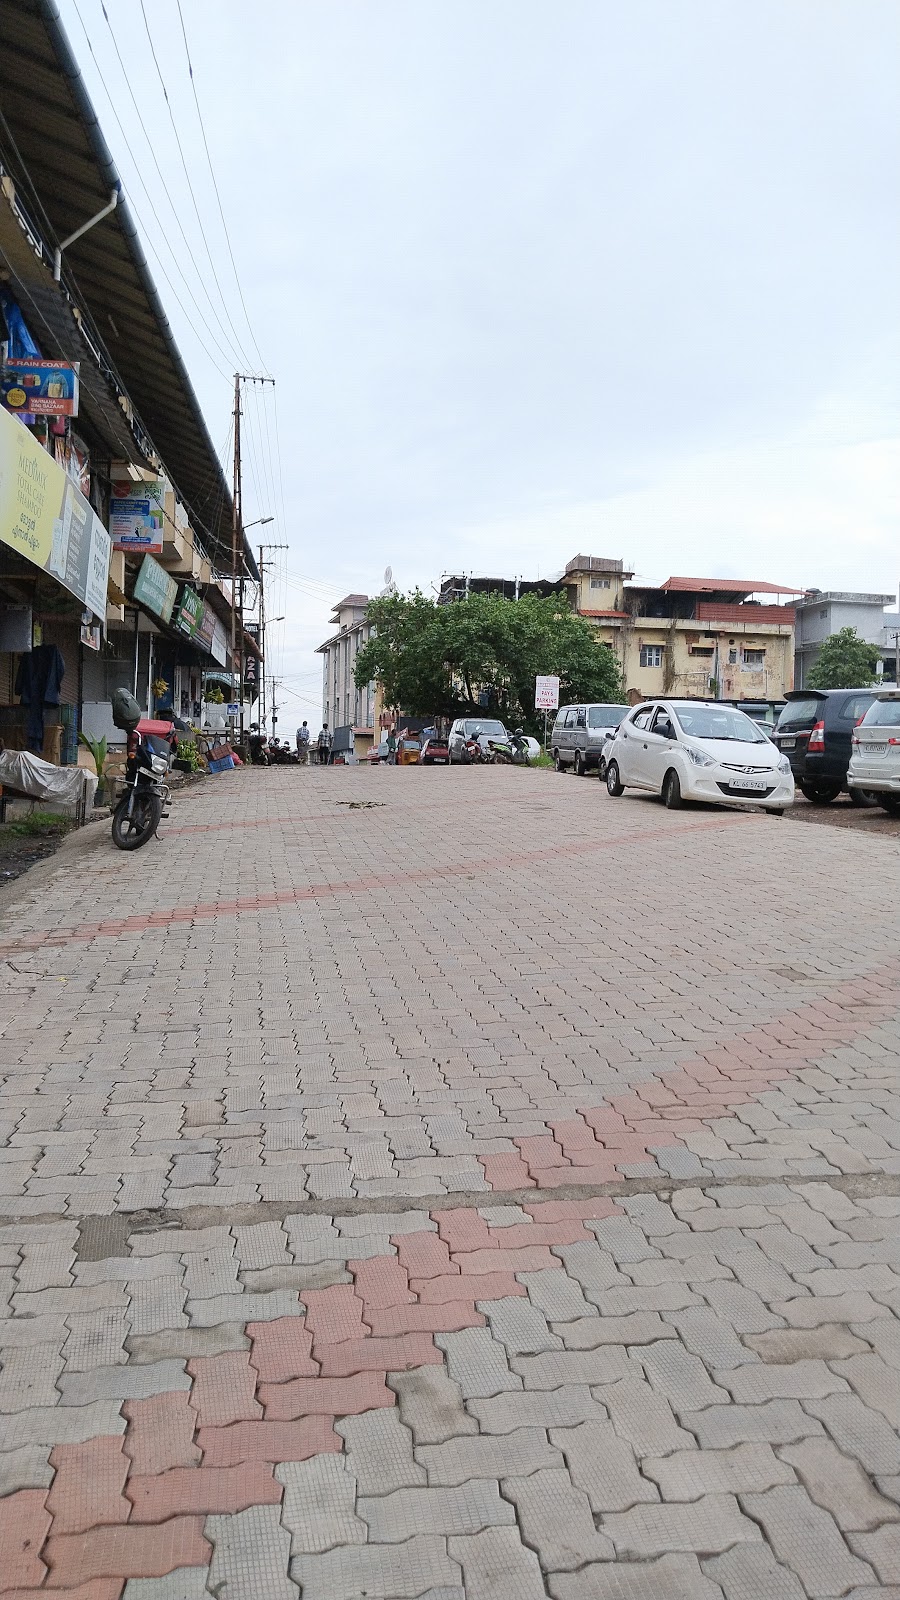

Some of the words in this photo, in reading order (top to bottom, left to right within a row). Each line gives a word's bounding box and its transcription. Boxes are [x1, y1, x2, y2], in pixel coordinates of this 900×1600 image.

[19, 455, 47, 490] MEDIMIX
[17, 490, 41, 518] SHAMPOO
[18, 473, 32, 496] TOTAL
[33, 488, 44, 507] CARE
[247, 656, 255, 679] AZA
